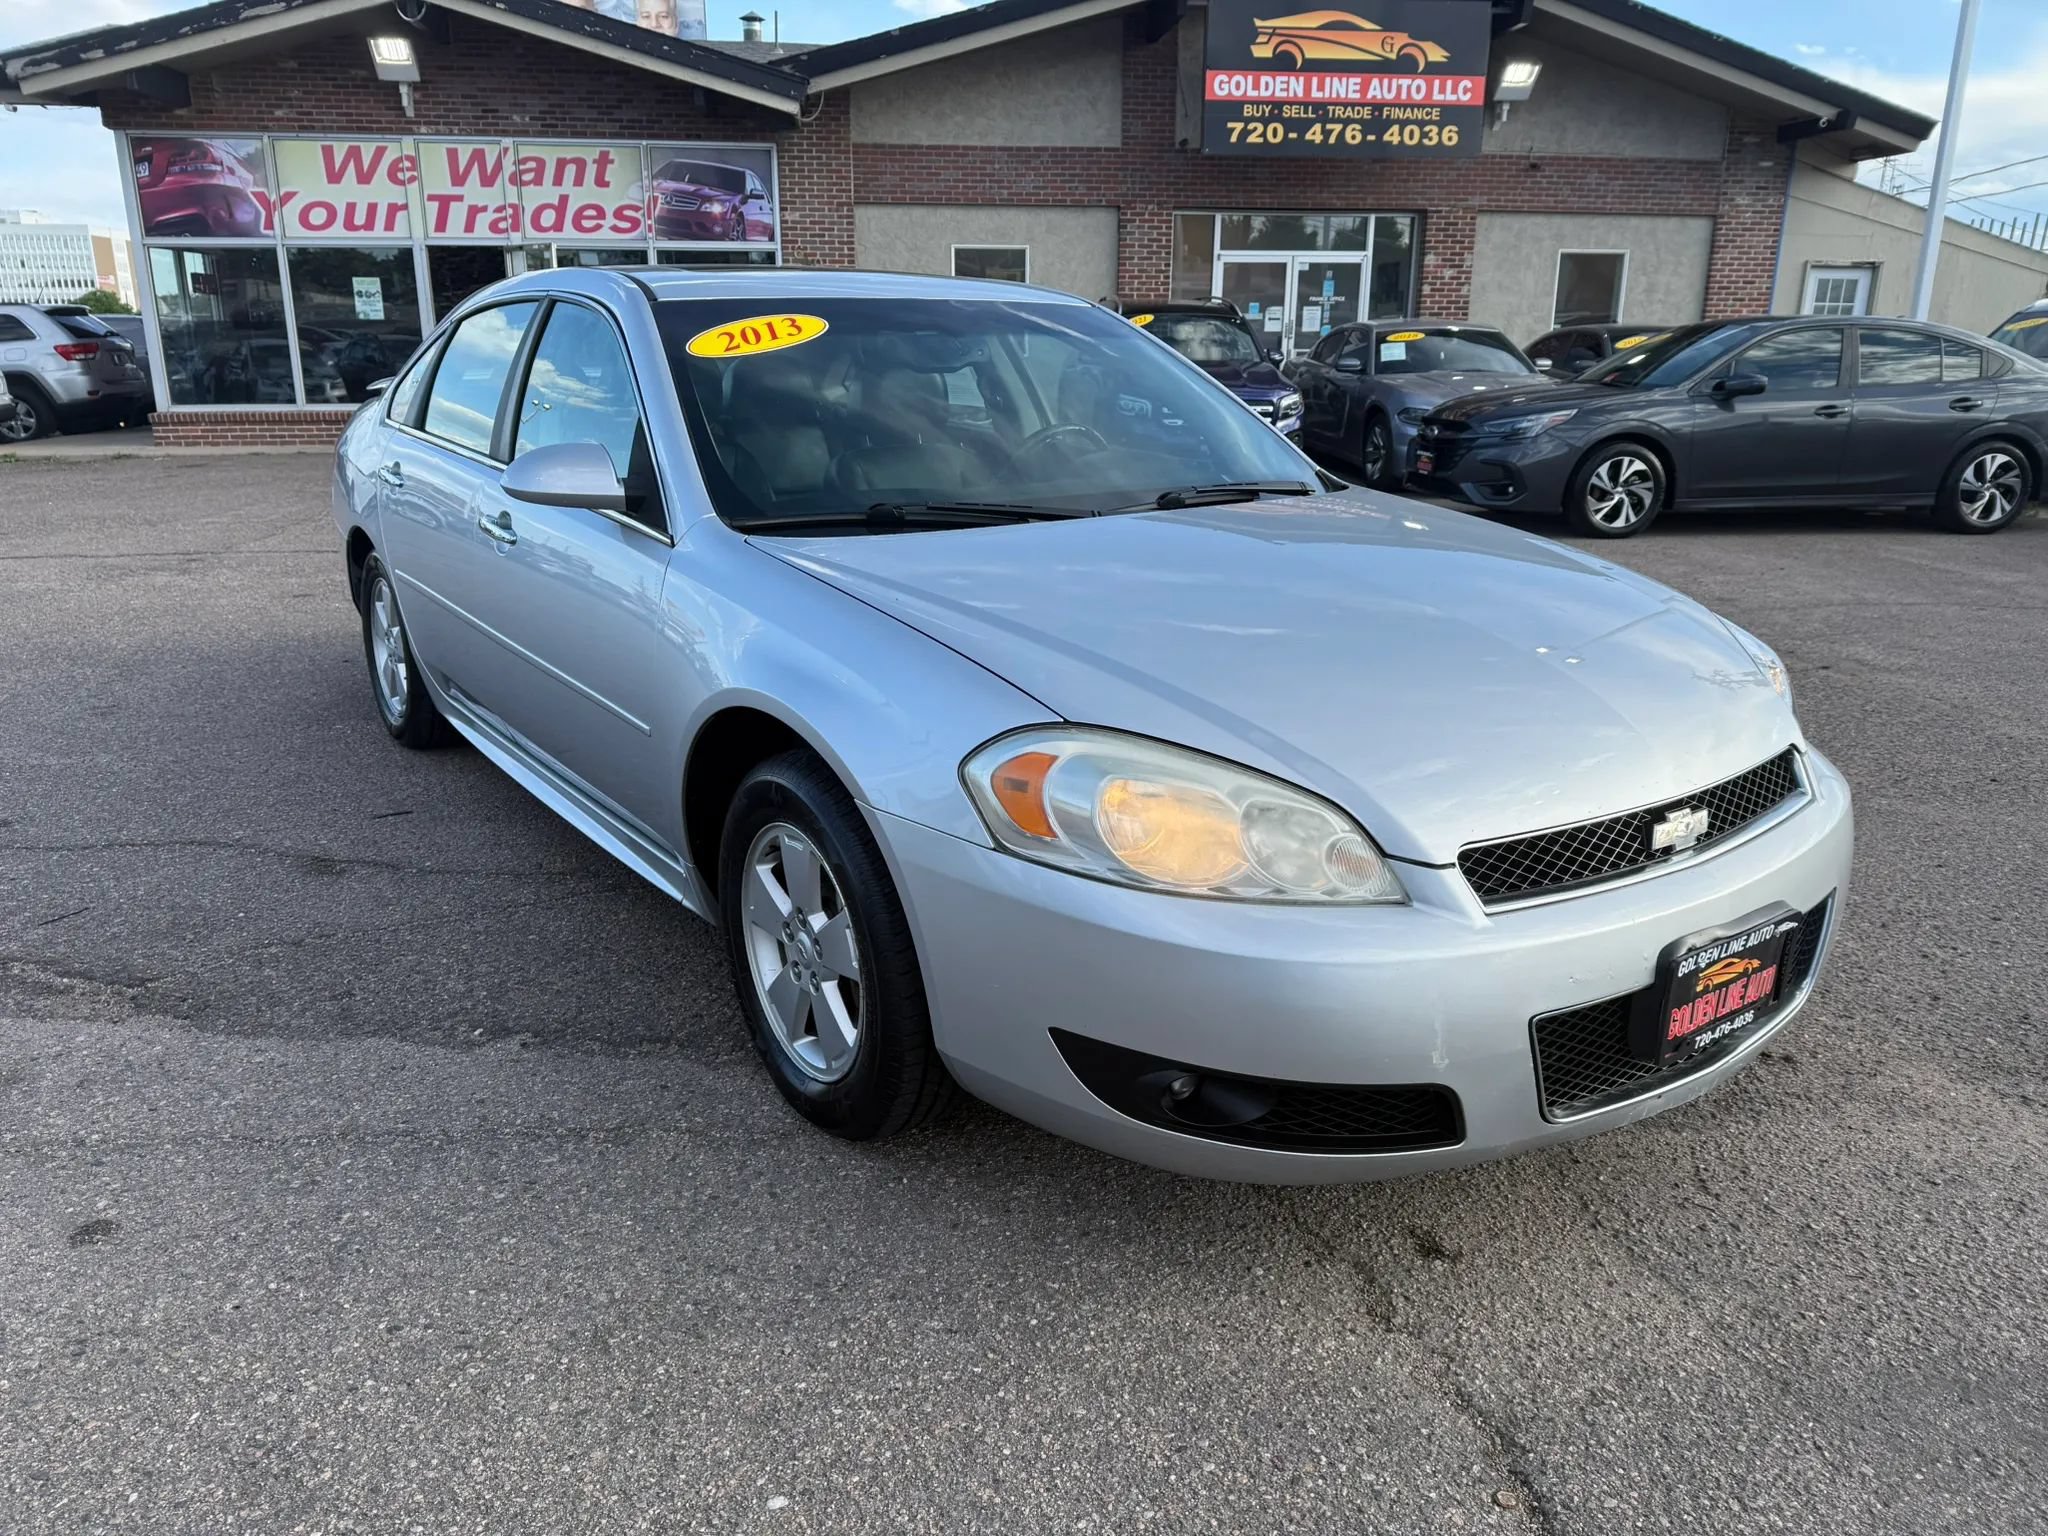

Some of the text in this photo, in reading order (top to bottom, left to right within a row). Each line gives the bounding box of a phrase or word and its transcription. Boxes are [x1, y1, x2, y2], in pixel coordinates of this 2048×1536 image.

[1213, 74, 1473, 101] GOLDEN LINE AUTO LLC
[1243, 104, 1441, 120] BUY SELL TRADE FINANCE
[320, 144, 616, 189] We Want
[250, 190, 660, 234] Your Trades!
[717, 317, 803, 353] 2013
[1720, 935, 1748, 959] LINE
[1746, 924, 1775, 948] AUTO
[1667, 964, 1777, 1040] GOLDEN LINE AUTO
[1694, 1010, 1755, 1049] 720-476-4036
